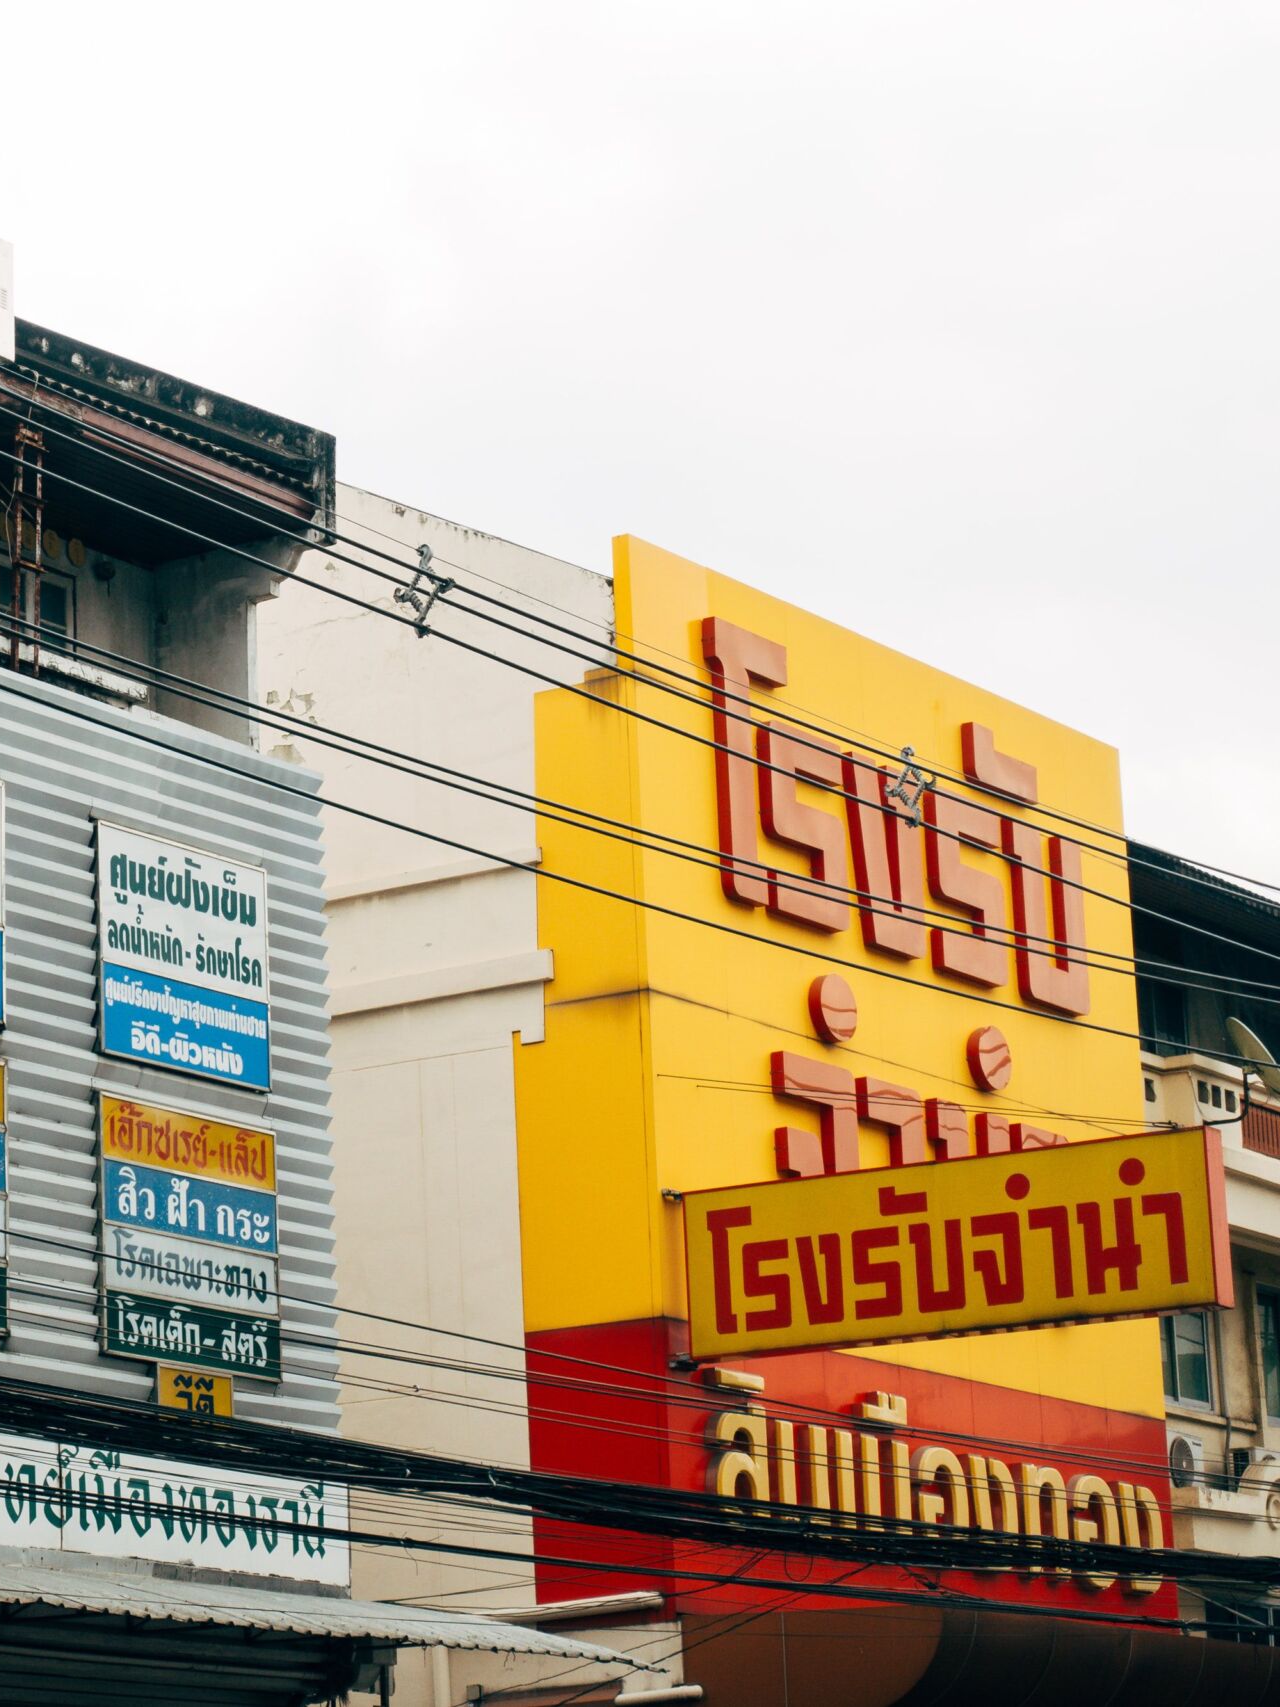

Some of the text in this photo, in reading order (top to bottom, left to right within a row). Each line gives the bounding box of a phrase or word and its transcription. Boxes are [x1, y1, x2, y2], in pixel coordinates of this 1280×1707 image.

[702, 616, 1090, 1017] โรงรับ
[110, 853, 256, 927] ศูนย์ฝังเข็ม
[118, 1166, 270, 1244] สิว ฝ้า กระ
[112, 1227, 266, 1304] โรคเฉพาะทาง
[706, 1157, 1189, 1336] โรงรับจำนำ
